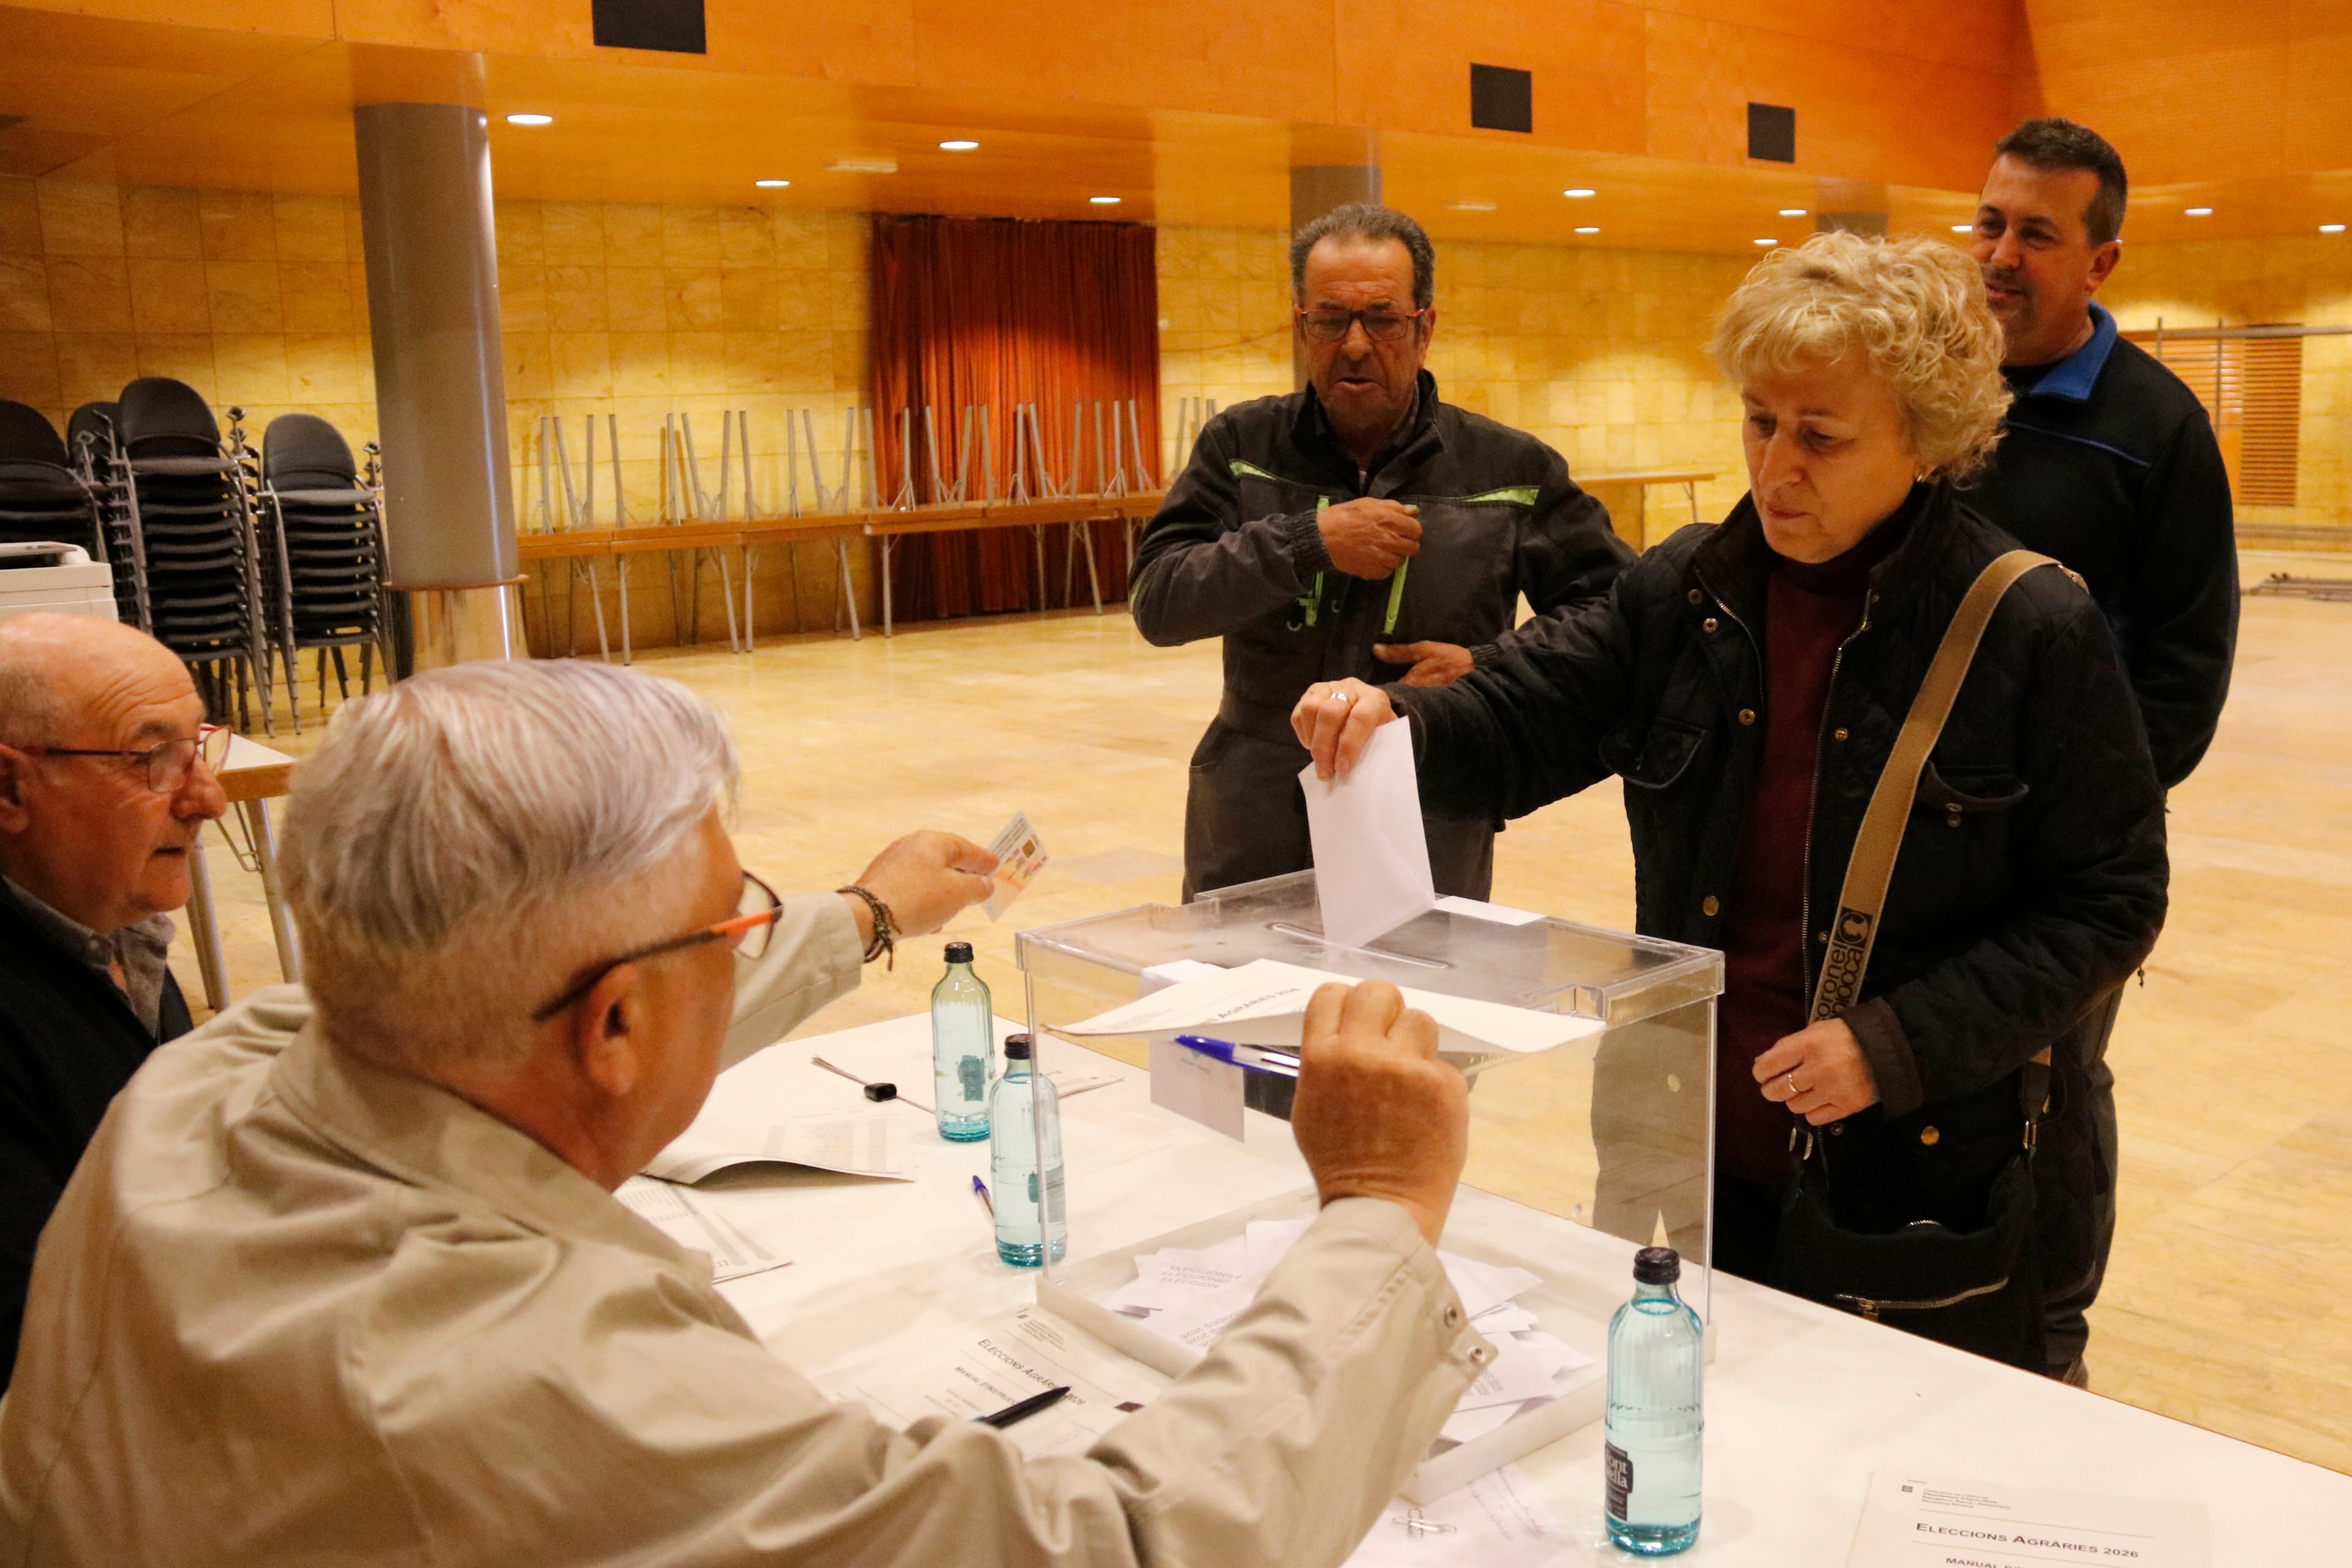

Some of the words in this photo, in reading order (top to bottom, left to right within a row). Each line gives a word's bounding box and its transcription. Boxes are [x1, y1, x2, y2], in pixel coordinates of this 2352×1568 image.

[1817, 942, 1848, 1019] oronel
[977, 1338, 1024, 1370] ELECCIONS
[1915, 1522, 2008, 1542] ELECCIONS
[2012, 1535, 2098, 1553] AGRÀRIES
[2103, 1547, 2139, 1558] 2026
